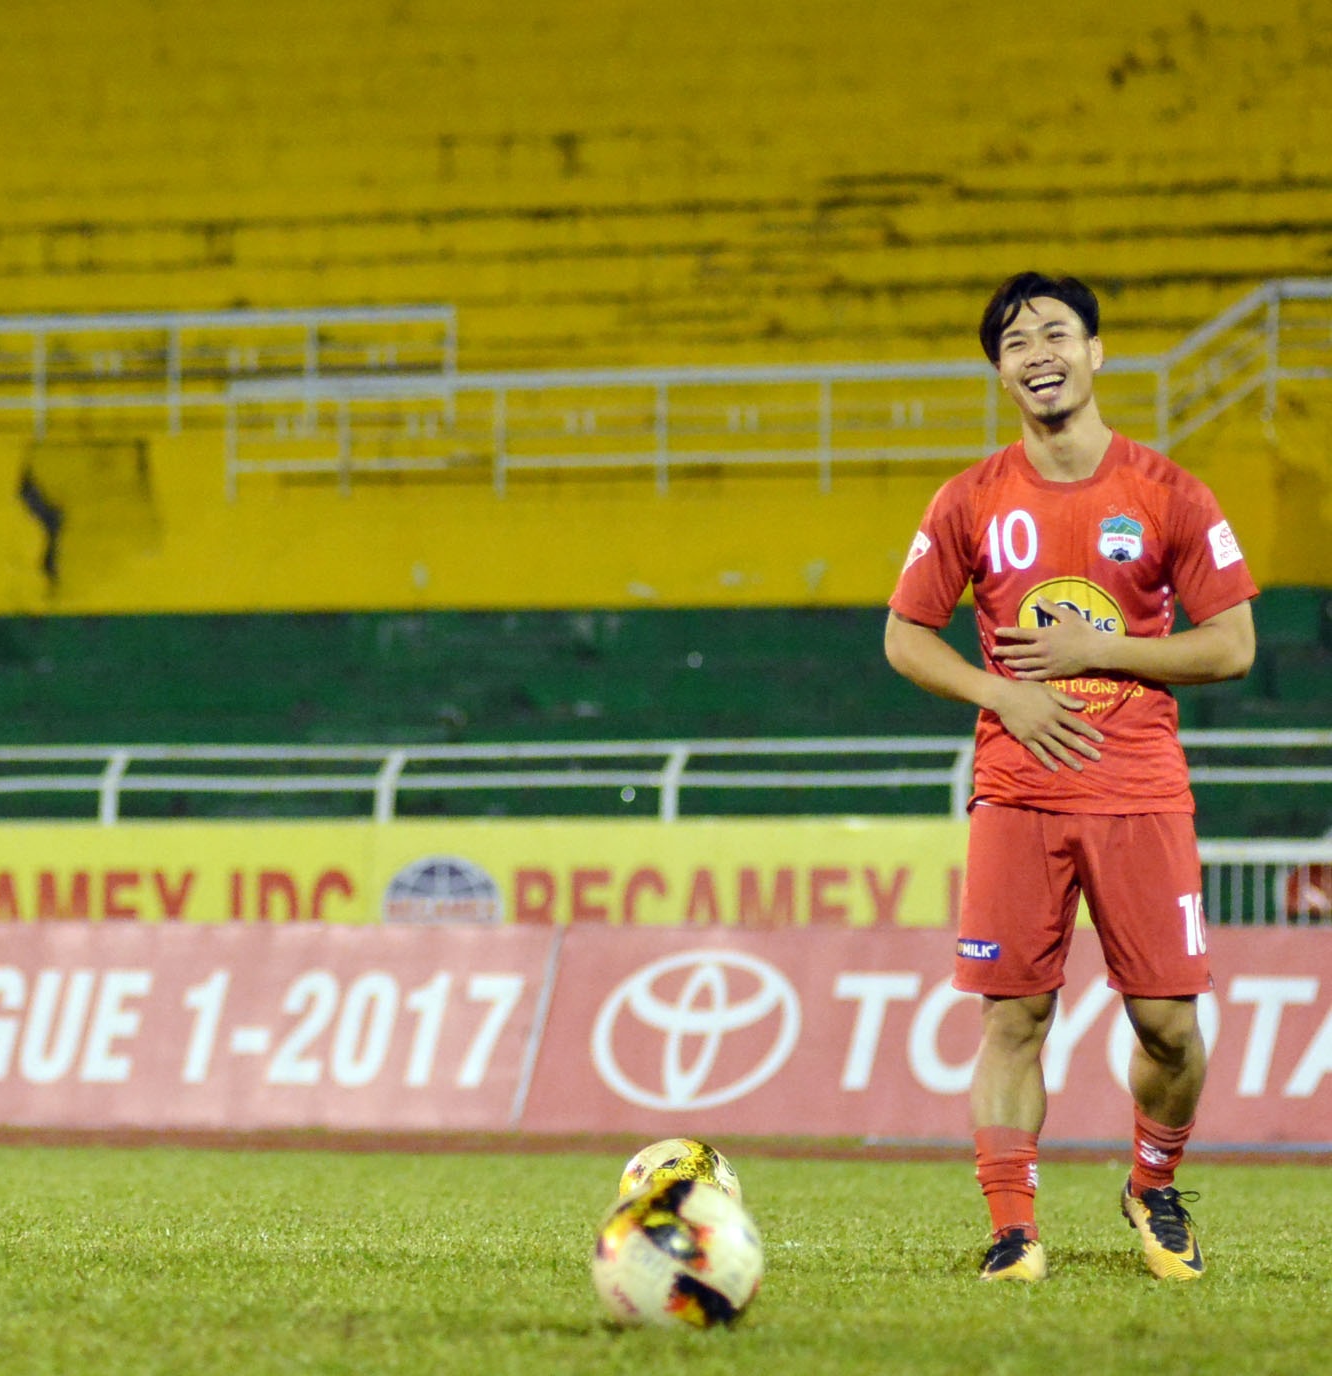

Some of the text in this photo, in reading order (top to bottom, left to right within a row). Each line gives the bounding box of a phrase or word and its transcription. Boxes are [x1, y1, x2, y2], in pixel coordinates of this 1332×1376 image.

[988, 510, 1037, 573] 10
[957, 942, 998, 958] MILK
[182, 970, 526, 1089] 1-2017
